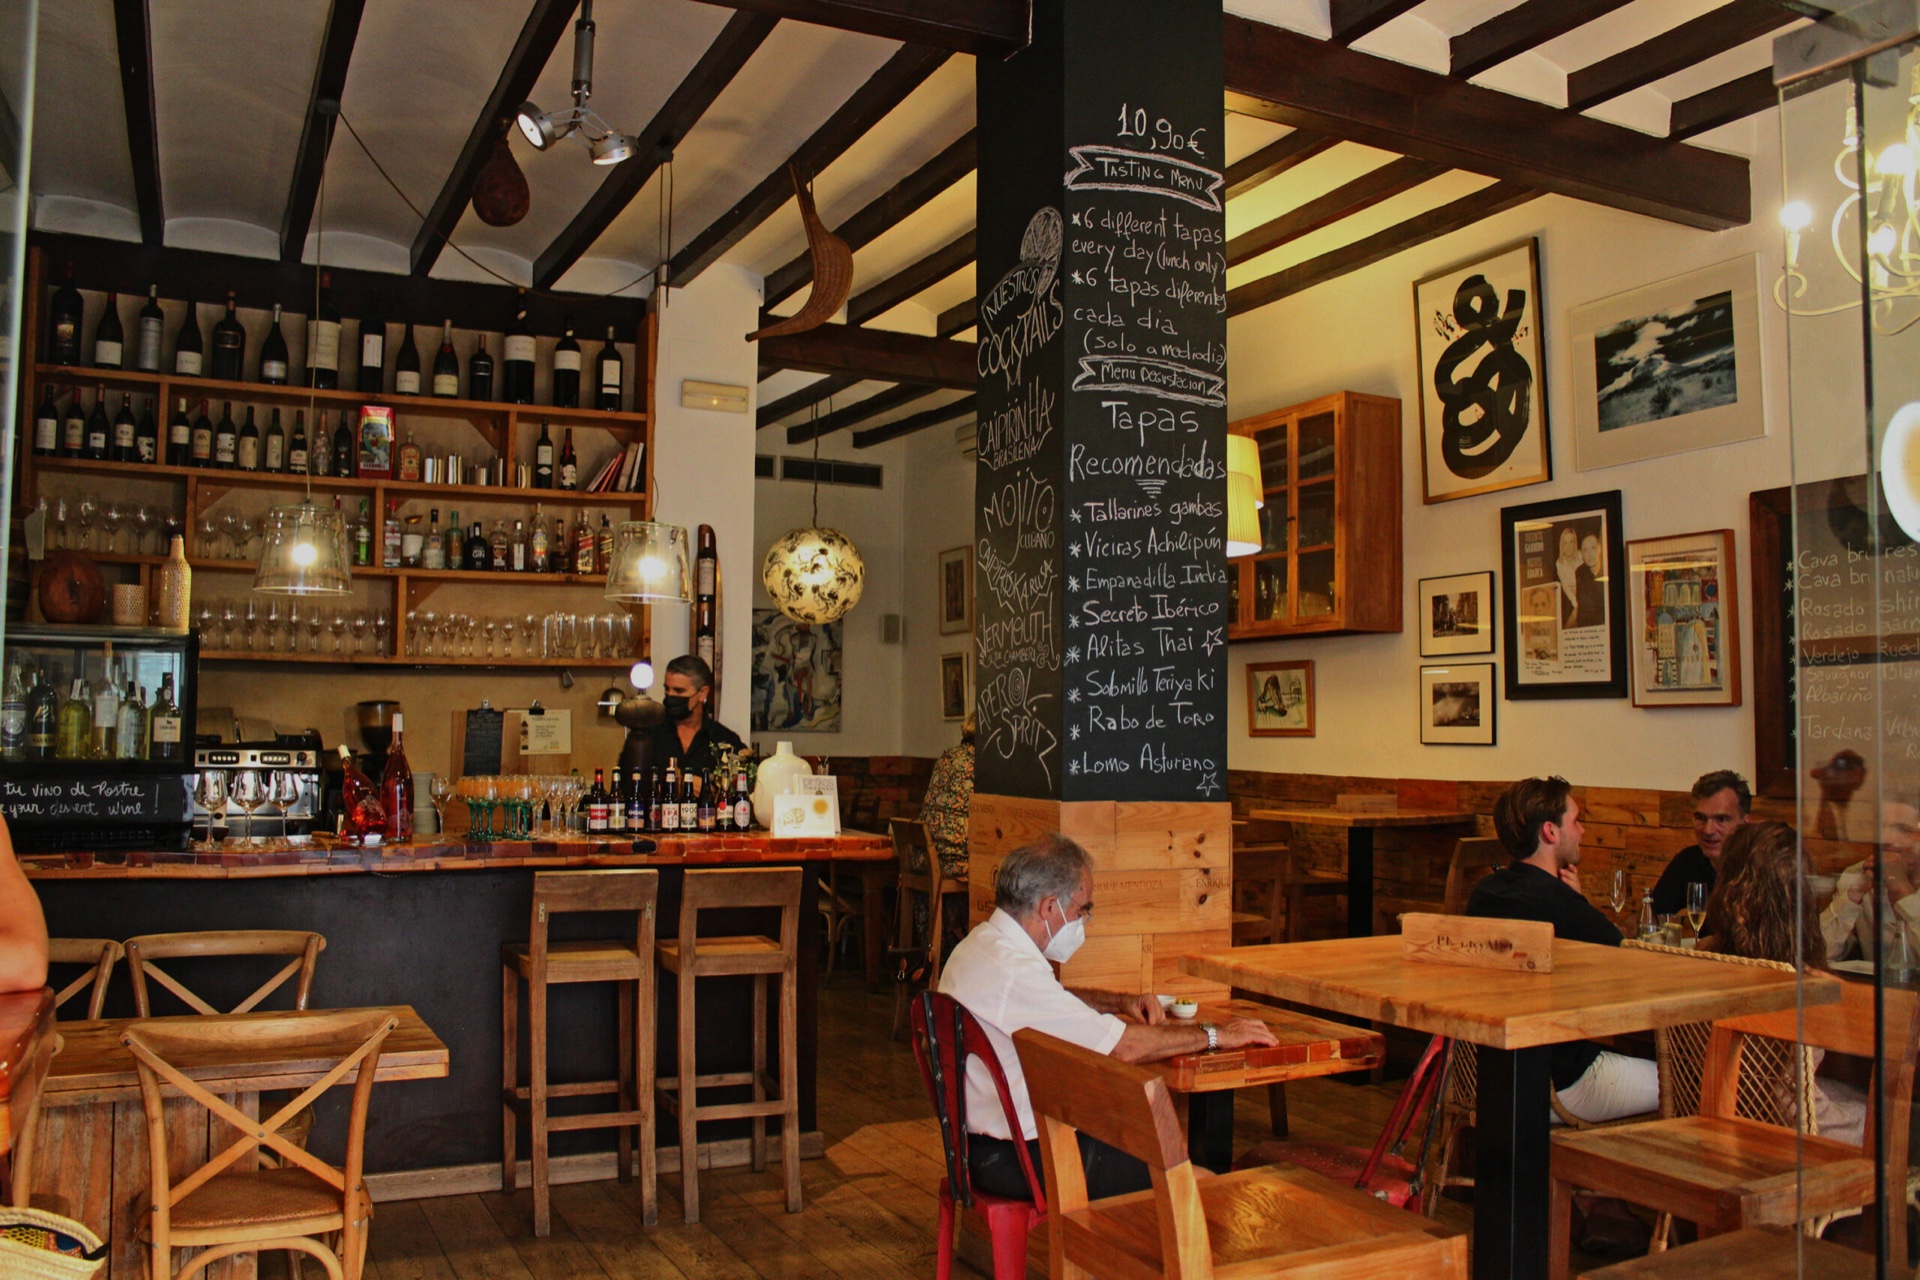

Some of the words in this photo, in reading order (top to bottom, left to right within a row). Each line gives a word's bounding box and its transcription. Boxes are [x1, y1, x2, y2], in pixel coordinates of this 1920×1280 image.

[1100, 208, 1168, 240] different
[1173, 212, 1223, 250] tapas
[1072, 239, 1116, 274] every
[1123, 238, 1154, 275] day
[1194, 252, 1227, 283] only)
[986, 267, 1041, 321] NUESTROS
[1108, 266, 1160, 307] tapas
[977, 278, 1064, 378] COCKTAILS
[1073, 301, 1126, 327] cada
[1137, 306, 1179, 335] dia
[1083, 328, 1136, 354] (solo
[1146, 346, 1158, 355] a
[1101, 401, 1199, 447] Tapas
[1069, 439, 1227, 483] Recomendadas
[1083, 497, 1162, 523] Tallarines
[1169, 492, 1223, 525] gambas
[1020, 531, 1055, 549] CUBANO
[1085, 530, 1142, 560] Vieiras
[1798, 550, 1838, 569] Cava
[1086, 562, 1176, 601] Empanadilla
[1180, 560, 1228, 585] India
[1798, 573, 1842, 590] Cava
[1082, 594, 1148, 626] Secreto
[1149, 593, 1220, 620] Ibérico
[1801, 597, 1864, 618] Rosado
[976, 592, 1055, 660] VERMOUTH
[1802, 620, 1867, 640] Rosado
[1086, 629, 1145, 661] Alitas
[1151, 627, 1194, 657] Thai
[1802, 644, 1859, 669] Verdejo
[977, 667, 1032, 735] APEROL
[1805, 685, 1873, 703] Albariño
[1088, 704, 1140, 733] Rabo
[1145, 704, 1167, 730] de
[1800, 714, 1873, 740] Tardana
[1083, 751, 1130, 775] Lomo
[1140, 742, 1215, 774] Asturiano
[70, 781, 90, 797] de
